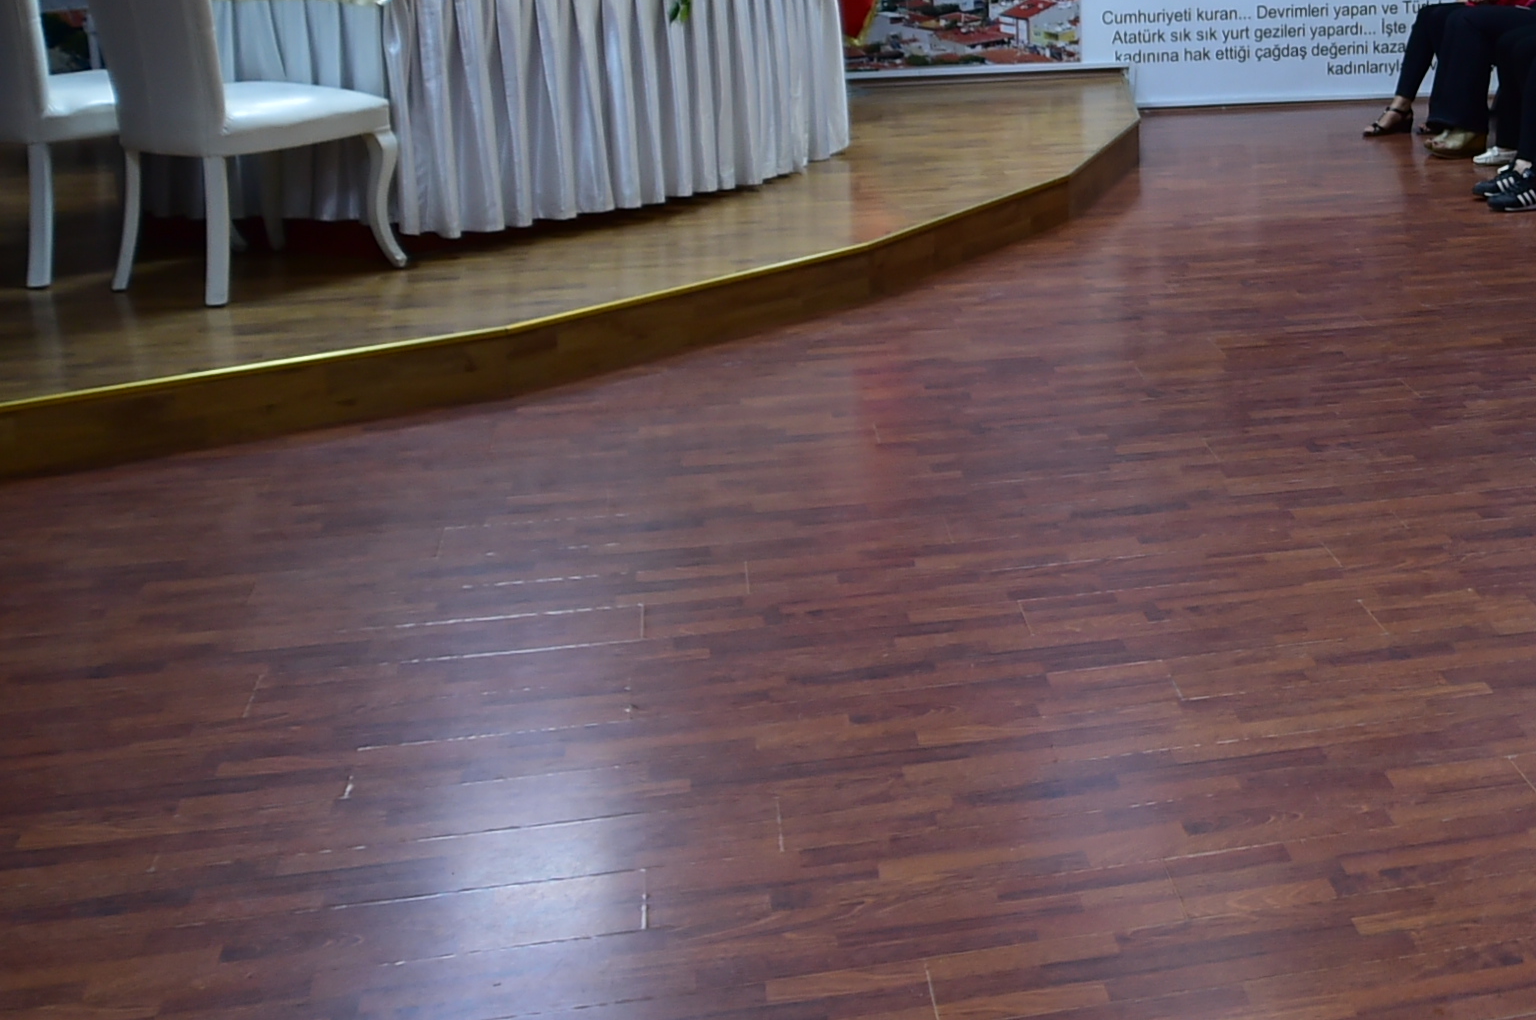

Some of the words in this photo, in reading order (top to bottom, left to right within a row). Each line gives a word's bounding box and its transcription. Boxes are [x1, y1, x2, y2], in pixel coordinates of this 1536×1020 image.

[1102, 8, 1191, 26] Cumhuriyeti
[1196, 7, 1251, 22] kuran...
[1256, 4, 1329, 20] Devrimleri
[1333, 5, 1377, 20] yapan
[1382, 5, 1398, 15] ve
[1112, 29, 1165, 44] Atatürk
[1171, 28, 1191, 42] sık
[1196, 27, 1217, 41] sık
[1222, 26, 1249, 43] yurt
[1254, 23, 1305, 42] gezileri
[1310, 23, 1376, 40] yapardı...
[1381, 19, 1406, 37] İşte
[1115, 49, 1179, 64] kadınına
[1184, 47, 1210, 62] hak
[1216, 45, 1250, 63] ettiği
[1255, 44, 1307, 62] çağdaş
[1311, 41, 1368, 59] değerini
[1373, 41, 1407, 54] kaza
[1327, 60, 1403, 76] kadınlarıyl
